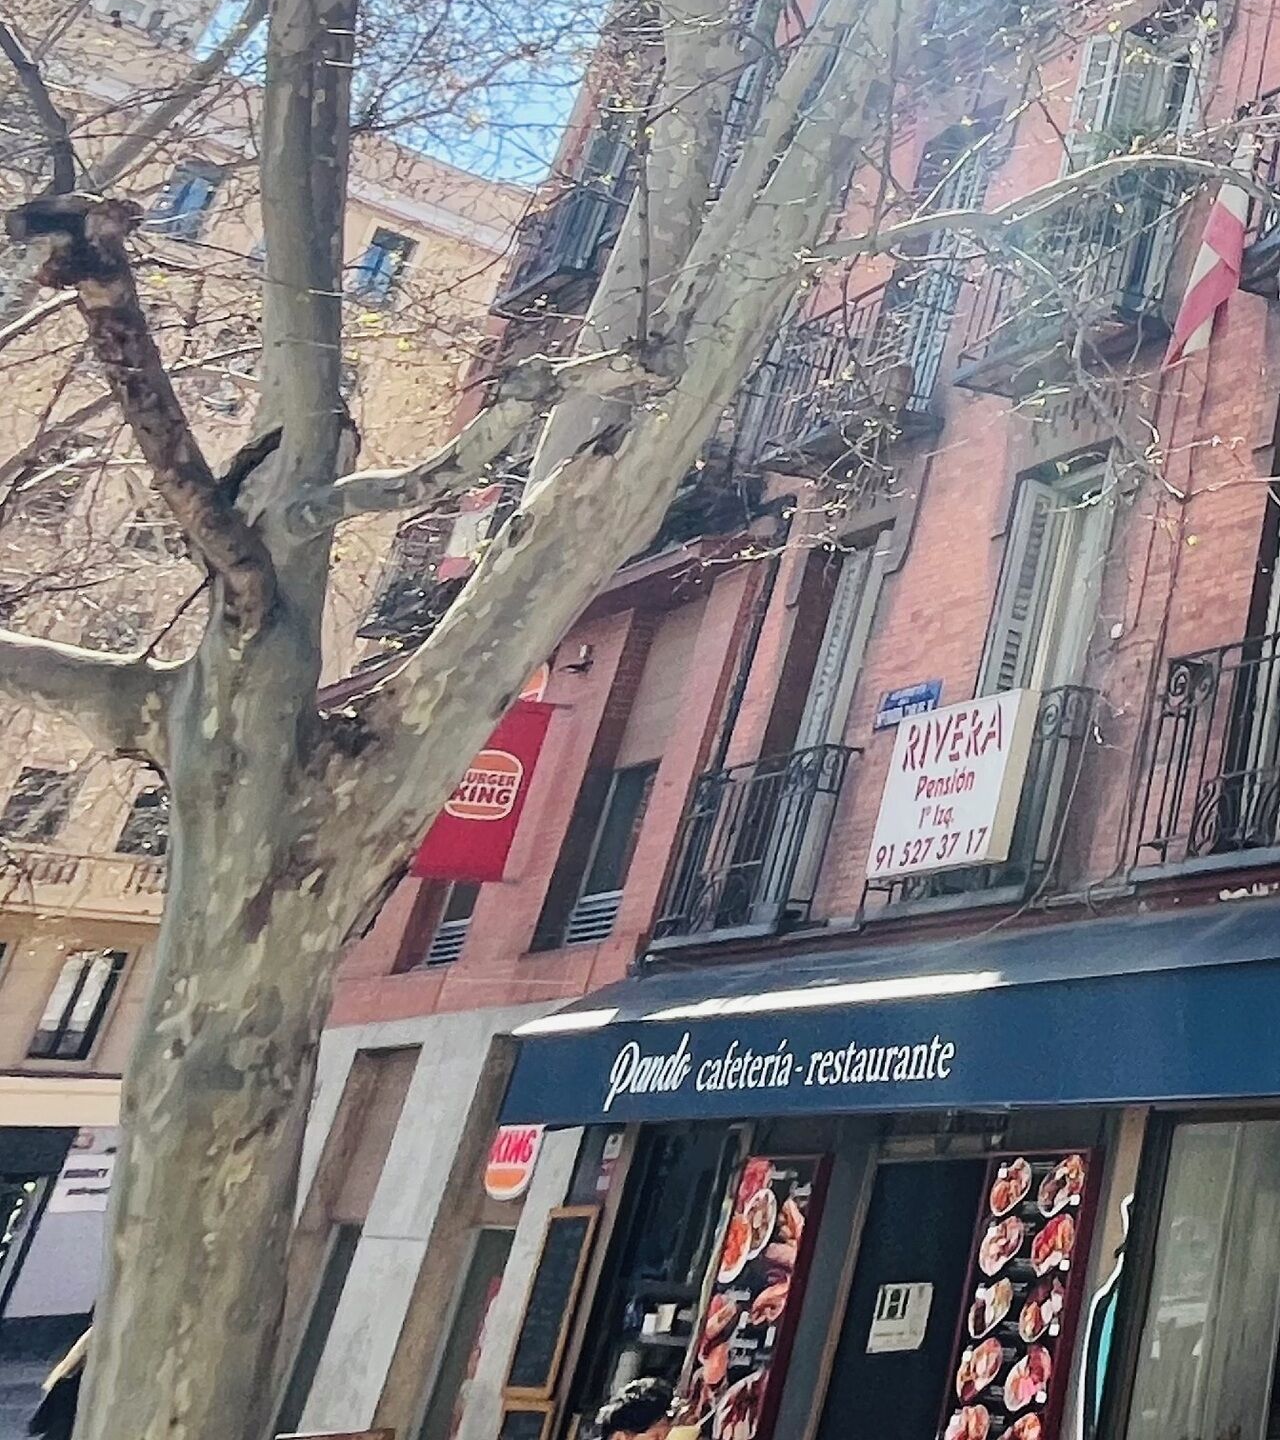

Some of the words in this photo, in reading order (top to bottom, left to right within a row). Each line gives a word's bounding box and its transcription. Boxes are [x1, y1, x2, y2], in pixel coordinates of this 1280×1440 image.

[903, 700, 1002, 771] RIVERA
[450, 785, 512, 805] KING
[466, 772, 516, 787] URGER
[915, 766, 975, 801] Pensión
[875, 844, 894, 871] 91
[899, 837, 935, 867] 527
[936, 832, 960, 860] 37
[966, 826, 988, 855] 17
[603, 1032, 691, 1112] Pando
[489, 1129, 537, 1163] KING
